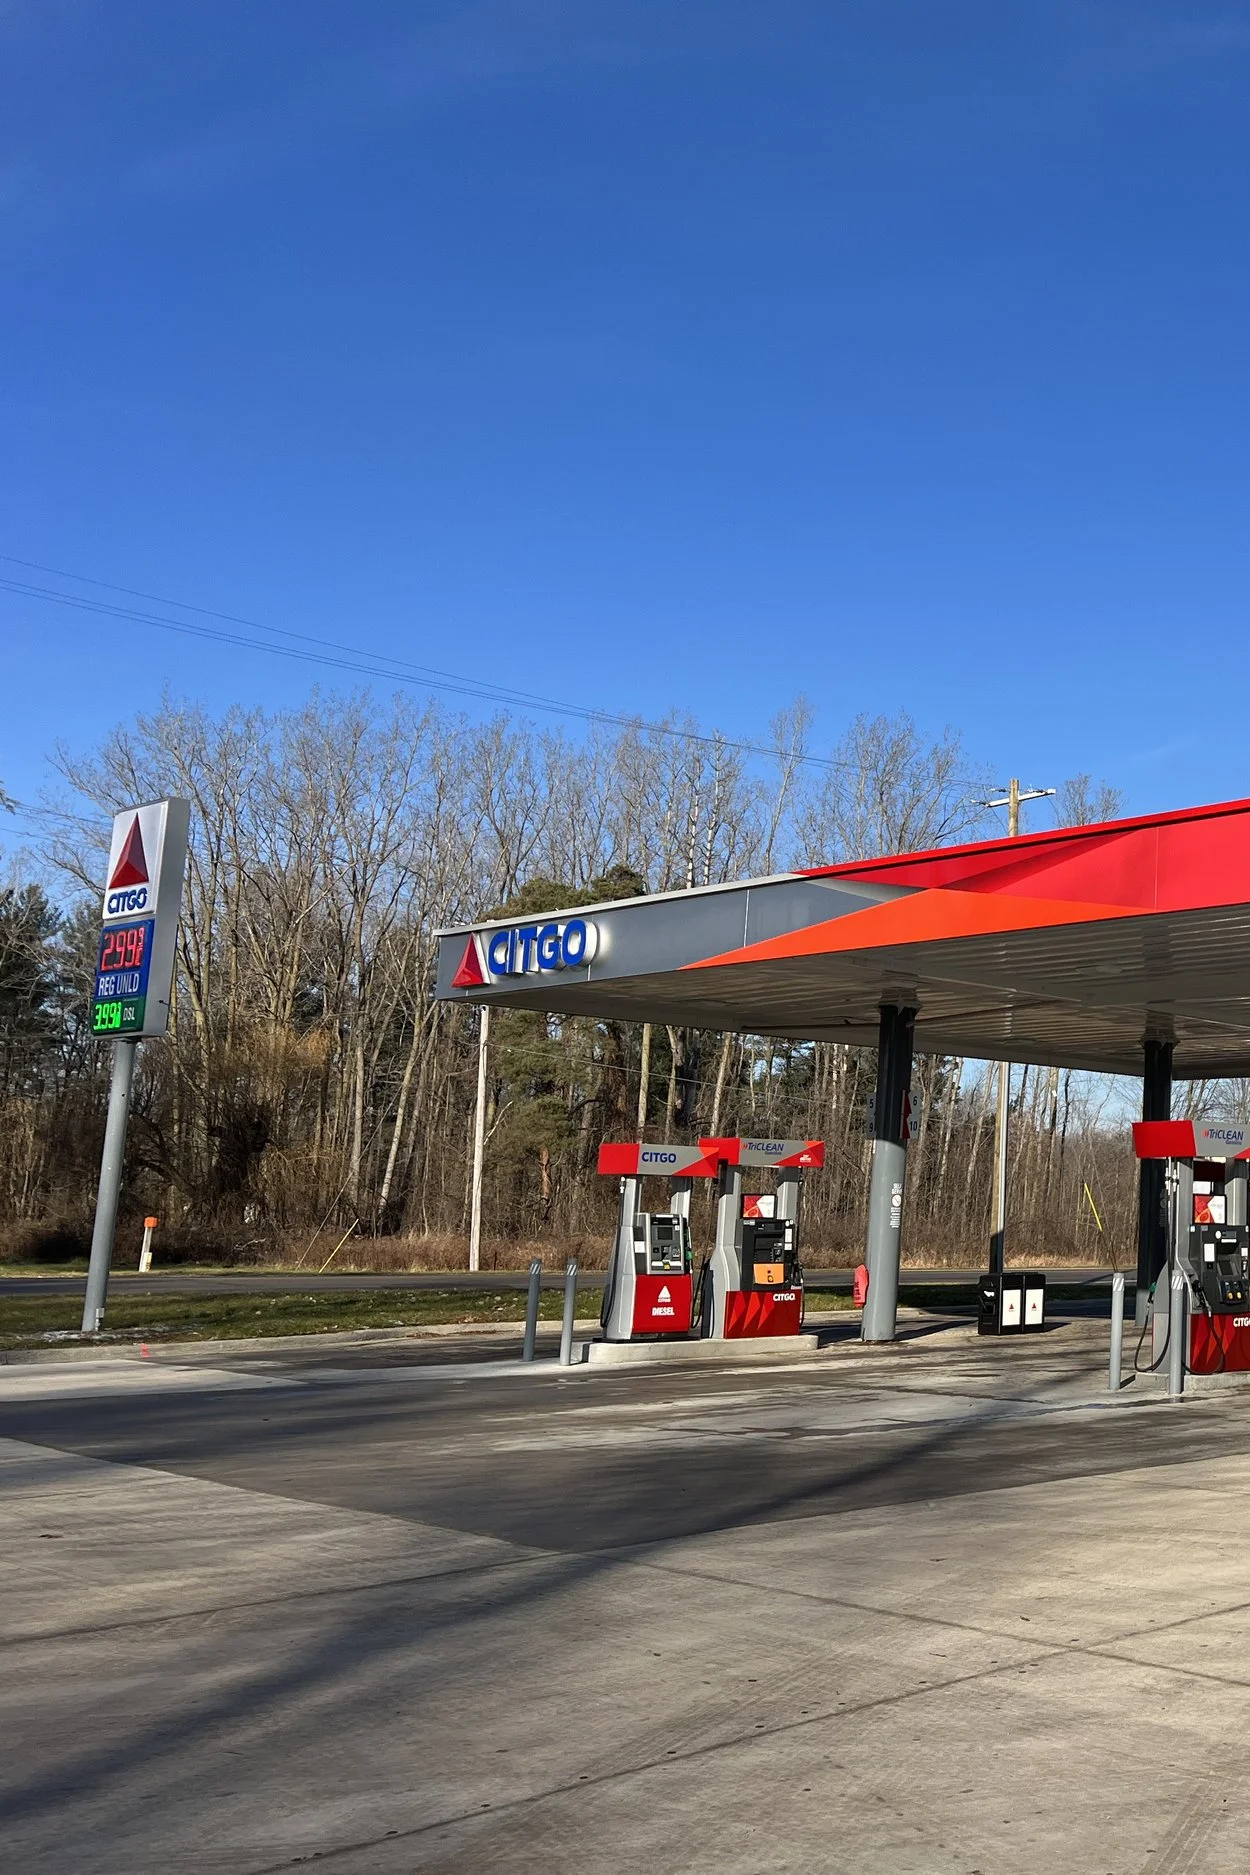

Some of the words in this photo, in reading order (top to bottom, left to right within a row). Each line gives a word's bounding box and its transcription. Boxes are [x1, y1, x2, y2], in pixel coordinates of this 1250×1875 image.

[108, 888, 147, 914] CITGO
[487, 919, 590, 976] CITGO
[98, 977, 115, 996] REG
[117, 973, 140, 994] UNLD
[123, 1006, 136, 1020] DSL
[869, 1099, 874, 1108] 5
[912, 1096, 918, 1106] 6
[869, 1122, 874, 1132] 9
[909, 1121, 918, 1131] 10
[1208, 1129, 1244, 1140] TriCLEAN
[747, 1142, 785, 1151] TriCLEAN
[641, 1152, 677, 1164] CITGO
[773, 1293, 796, 1302] CITGO
[652, 1306, 675, 1316] DIESEL
